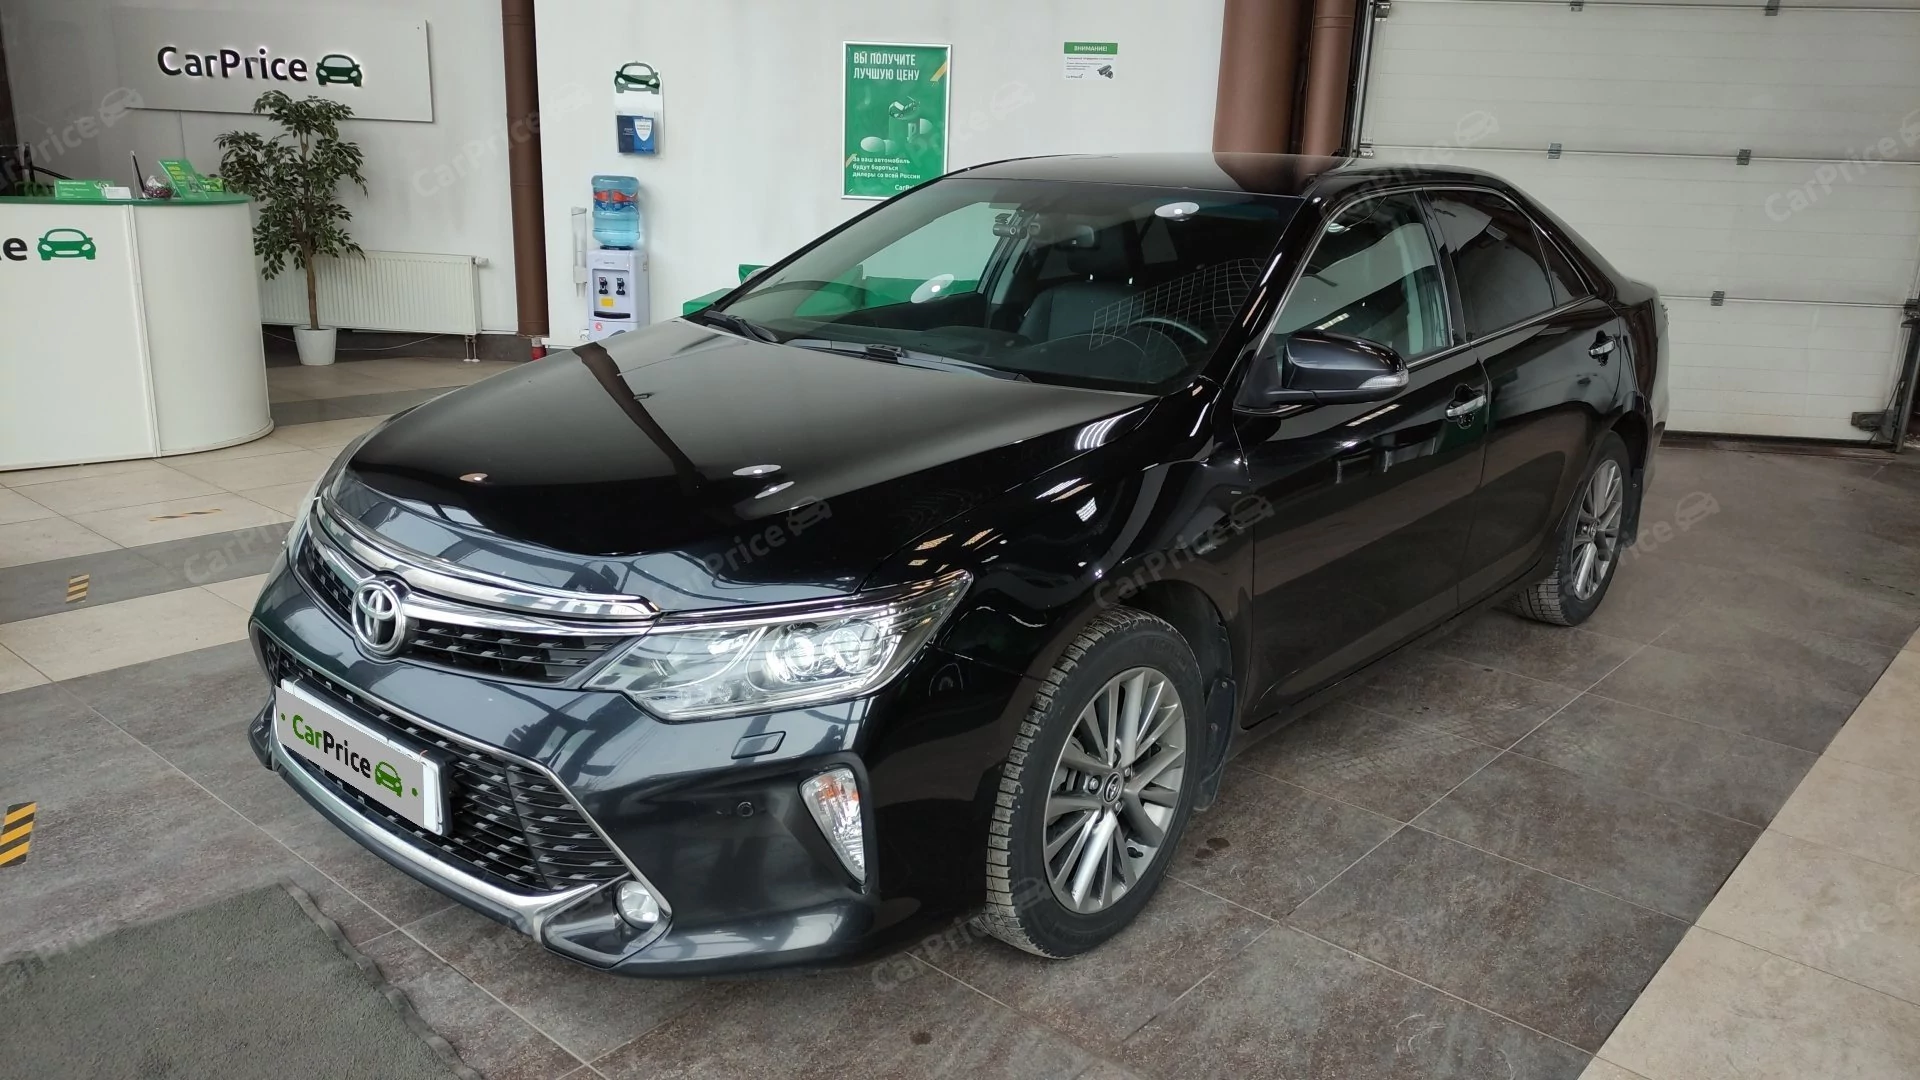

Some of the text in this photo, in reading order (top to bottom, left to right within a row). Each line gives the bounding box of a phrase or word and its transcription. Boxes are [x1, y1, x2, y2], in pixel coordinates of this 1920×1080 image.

[157, 46, 308, 82] CarPrice
[853, 52, 916, 66] ВЫ ПОЛУЧИТЕ
[853, 67, 920, 82] ЛУЧШУЮ ЦЕНУ
